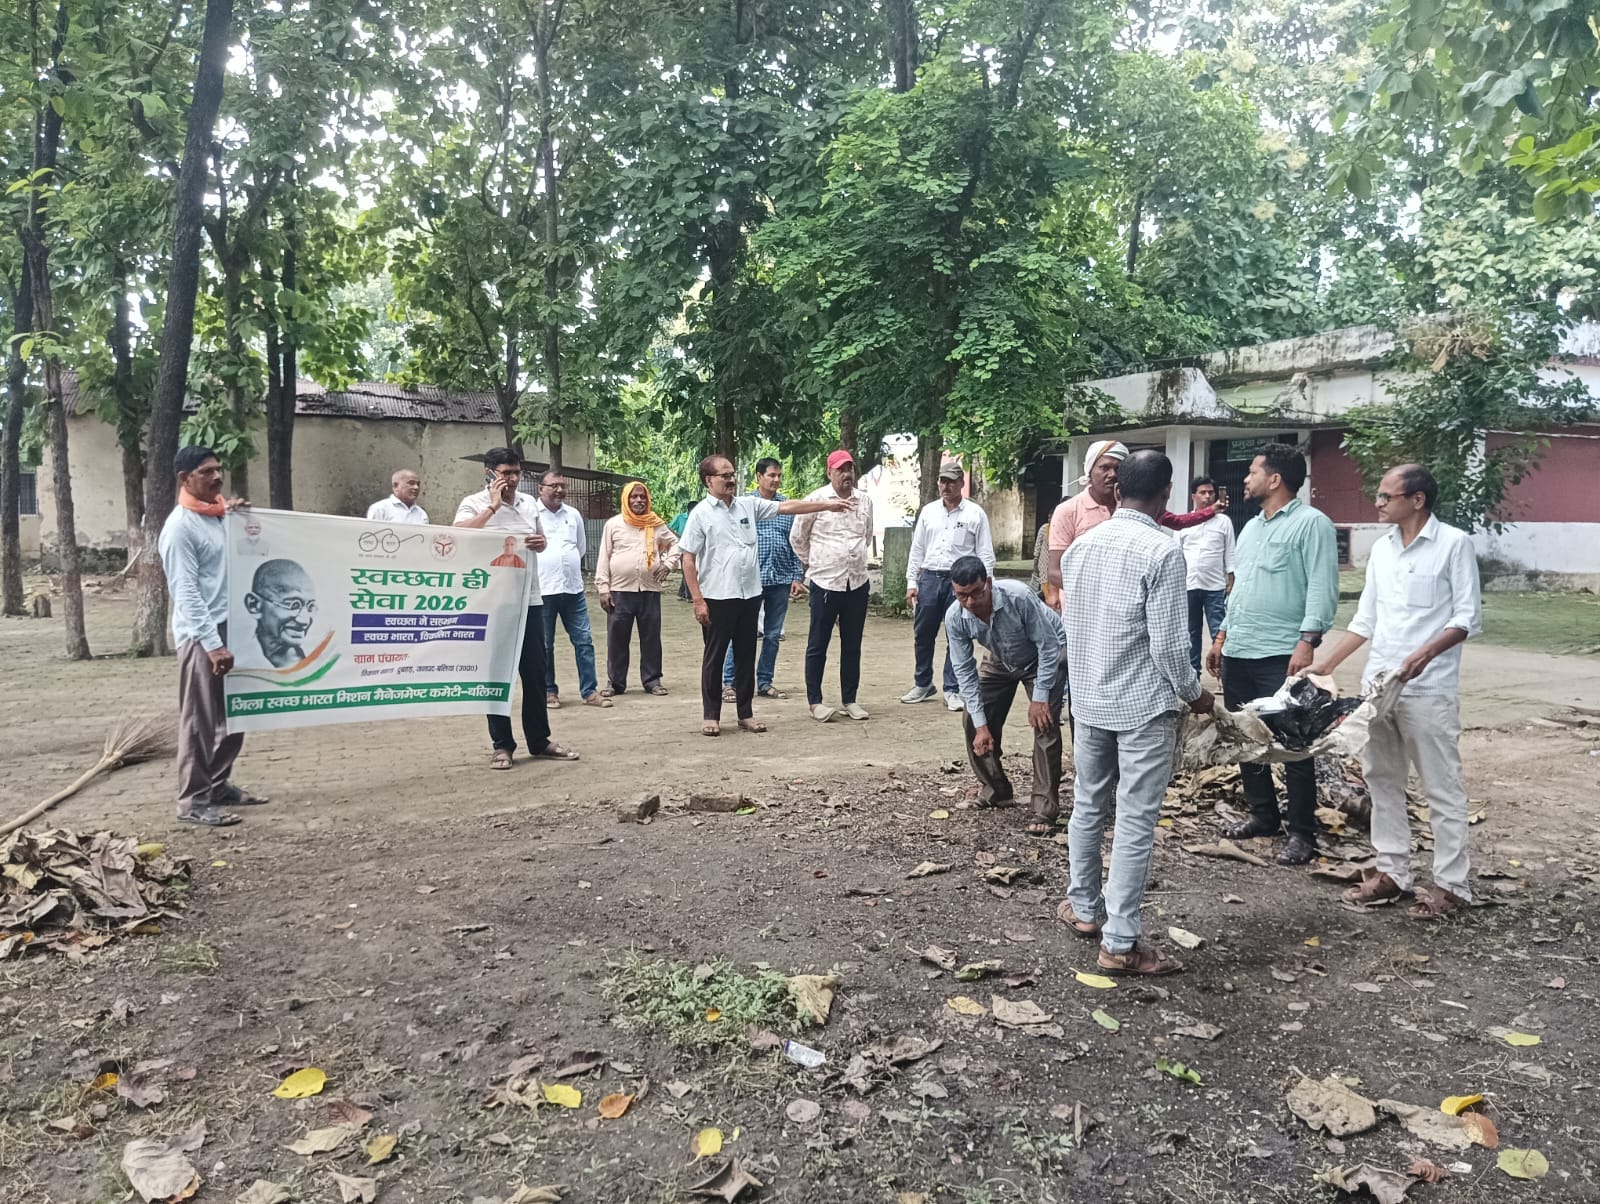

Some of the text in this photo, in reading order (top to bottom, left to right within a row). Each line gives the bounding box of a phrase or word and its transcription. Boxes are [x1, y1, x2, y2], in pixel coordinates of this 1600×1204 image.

[350, 568, 491, 589] स्वच्छता ही
[349, 588, 468, 611] सेवा 2026
[384, 617, 417, 626] स्वच्छता
[363, 632, 389, 641] स्वच्छ
[452, 630, 475, 639] भारत
[353, 654, 375, 664] ग्राम
[231, 696, 264, 712] जिला
[266, 696, 300, 710] स्वच्छ
[302, 693, 334, 706] भारत
[336, 690, 371, 703] मिशन
[373, 686, 428, 701] मैनेजमेण्ट
